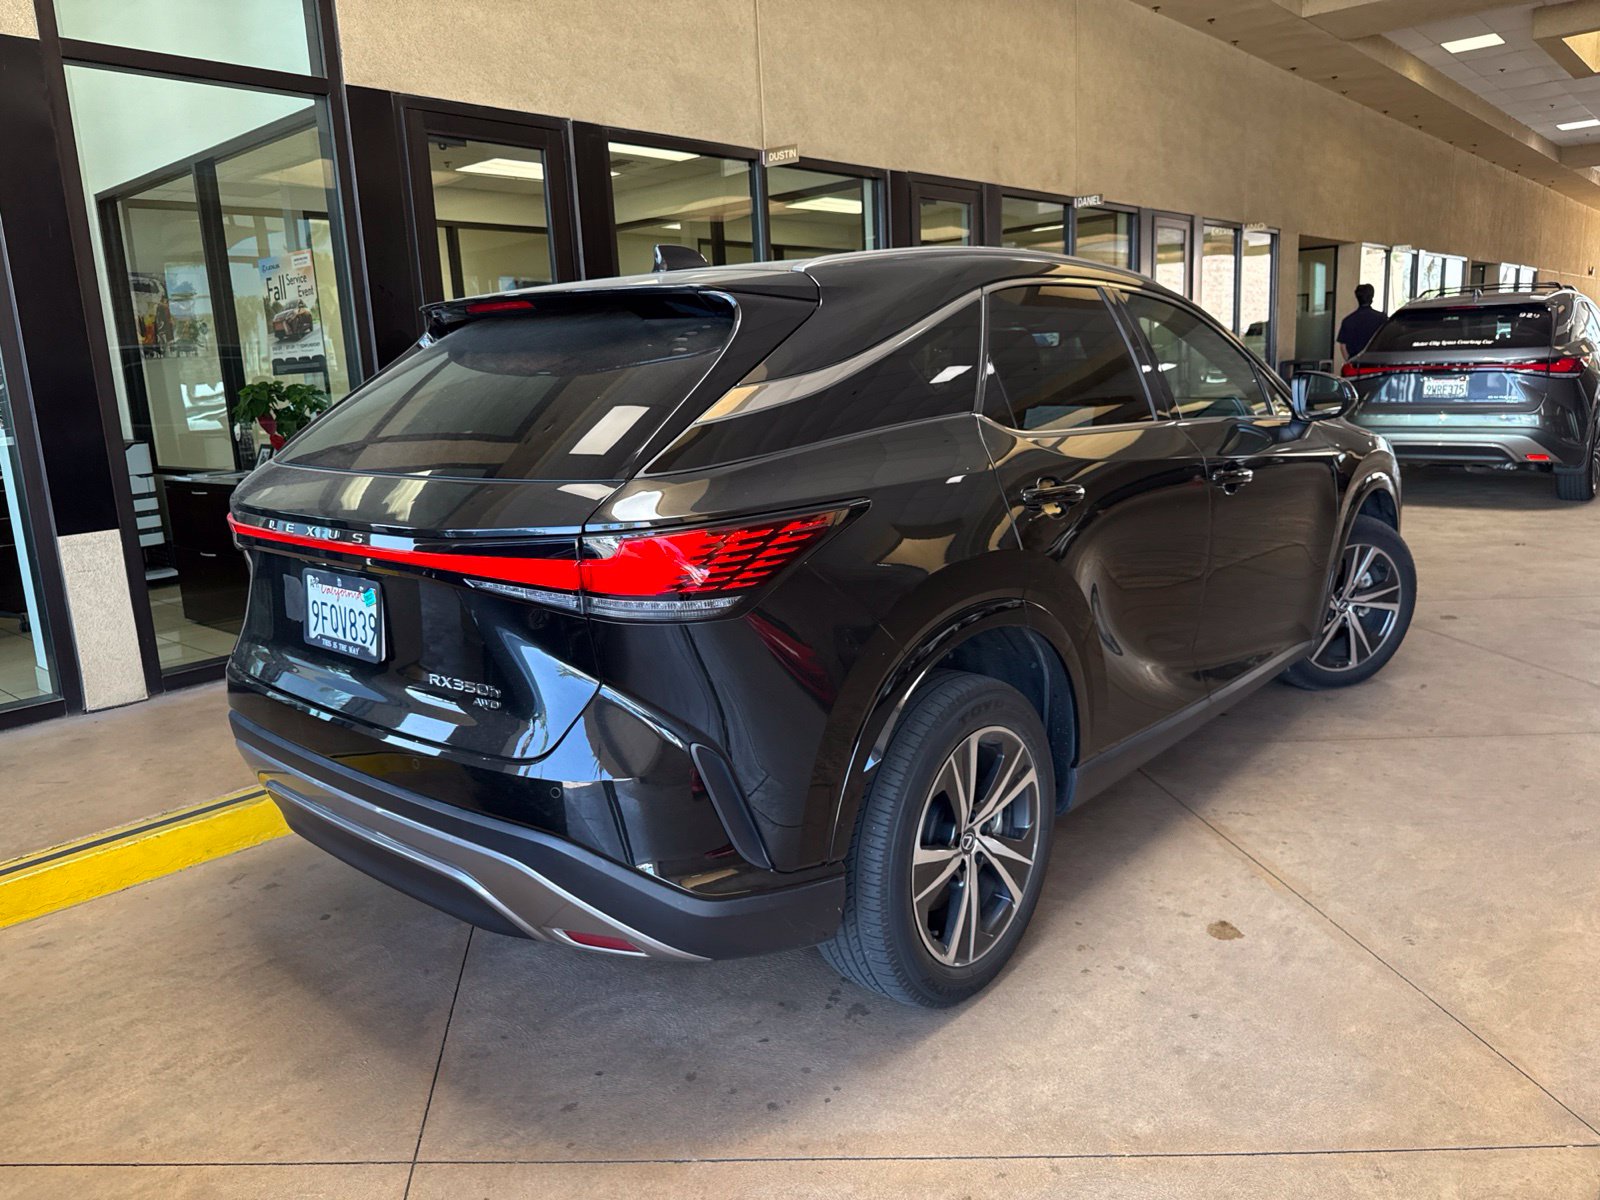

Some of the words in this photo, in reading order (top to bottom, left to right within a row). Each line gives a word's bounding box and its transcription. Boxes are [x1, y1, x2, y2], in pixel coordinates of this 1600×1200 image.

[769, 149, 797, 162] DUSTIN
[266, 274, 287, 301] Fall
[286, 273, 307, 286] Service
[298, 285, 314, 298] Event
[268, 519, 364, 544] LEXUS
[321, 584, 362, 602] California
[311, 600, 377, 647] 9FQV839
[322, 638, 332, 648] THIS
[339, 643, 348, 652] THE
[348, 645, 360, 655] WAY
[472, 697, 502, 711] AWD
